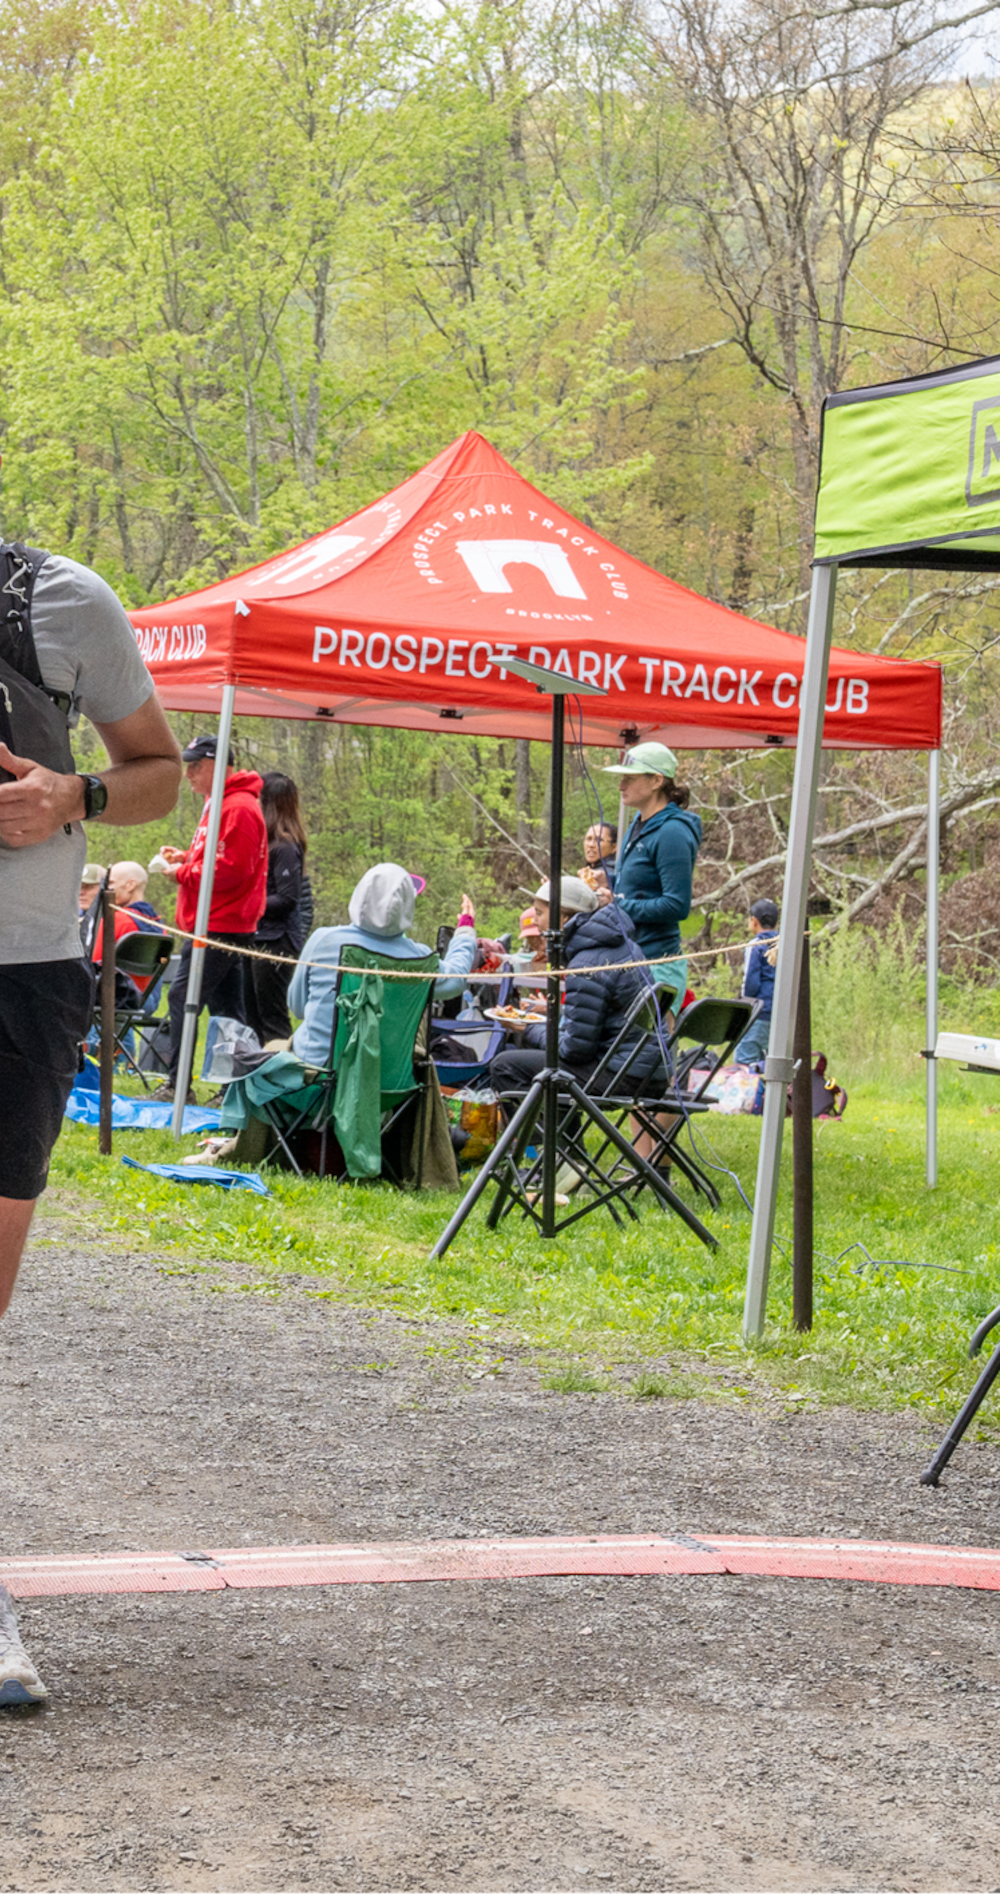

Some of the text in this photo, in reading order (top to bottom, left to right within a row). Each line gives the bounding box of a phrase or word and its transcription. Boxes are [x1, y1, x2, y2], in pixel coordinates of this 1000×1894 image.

[412, 503, 629, 600] PROSPECT PARK TRACK CLUB
[135, 623, 207, 662] RACK CLUB
[505, 607, 594, 621] BROOKLYN
[312, 626, 869, 714] PROSPECT PARK TRACK CUB
